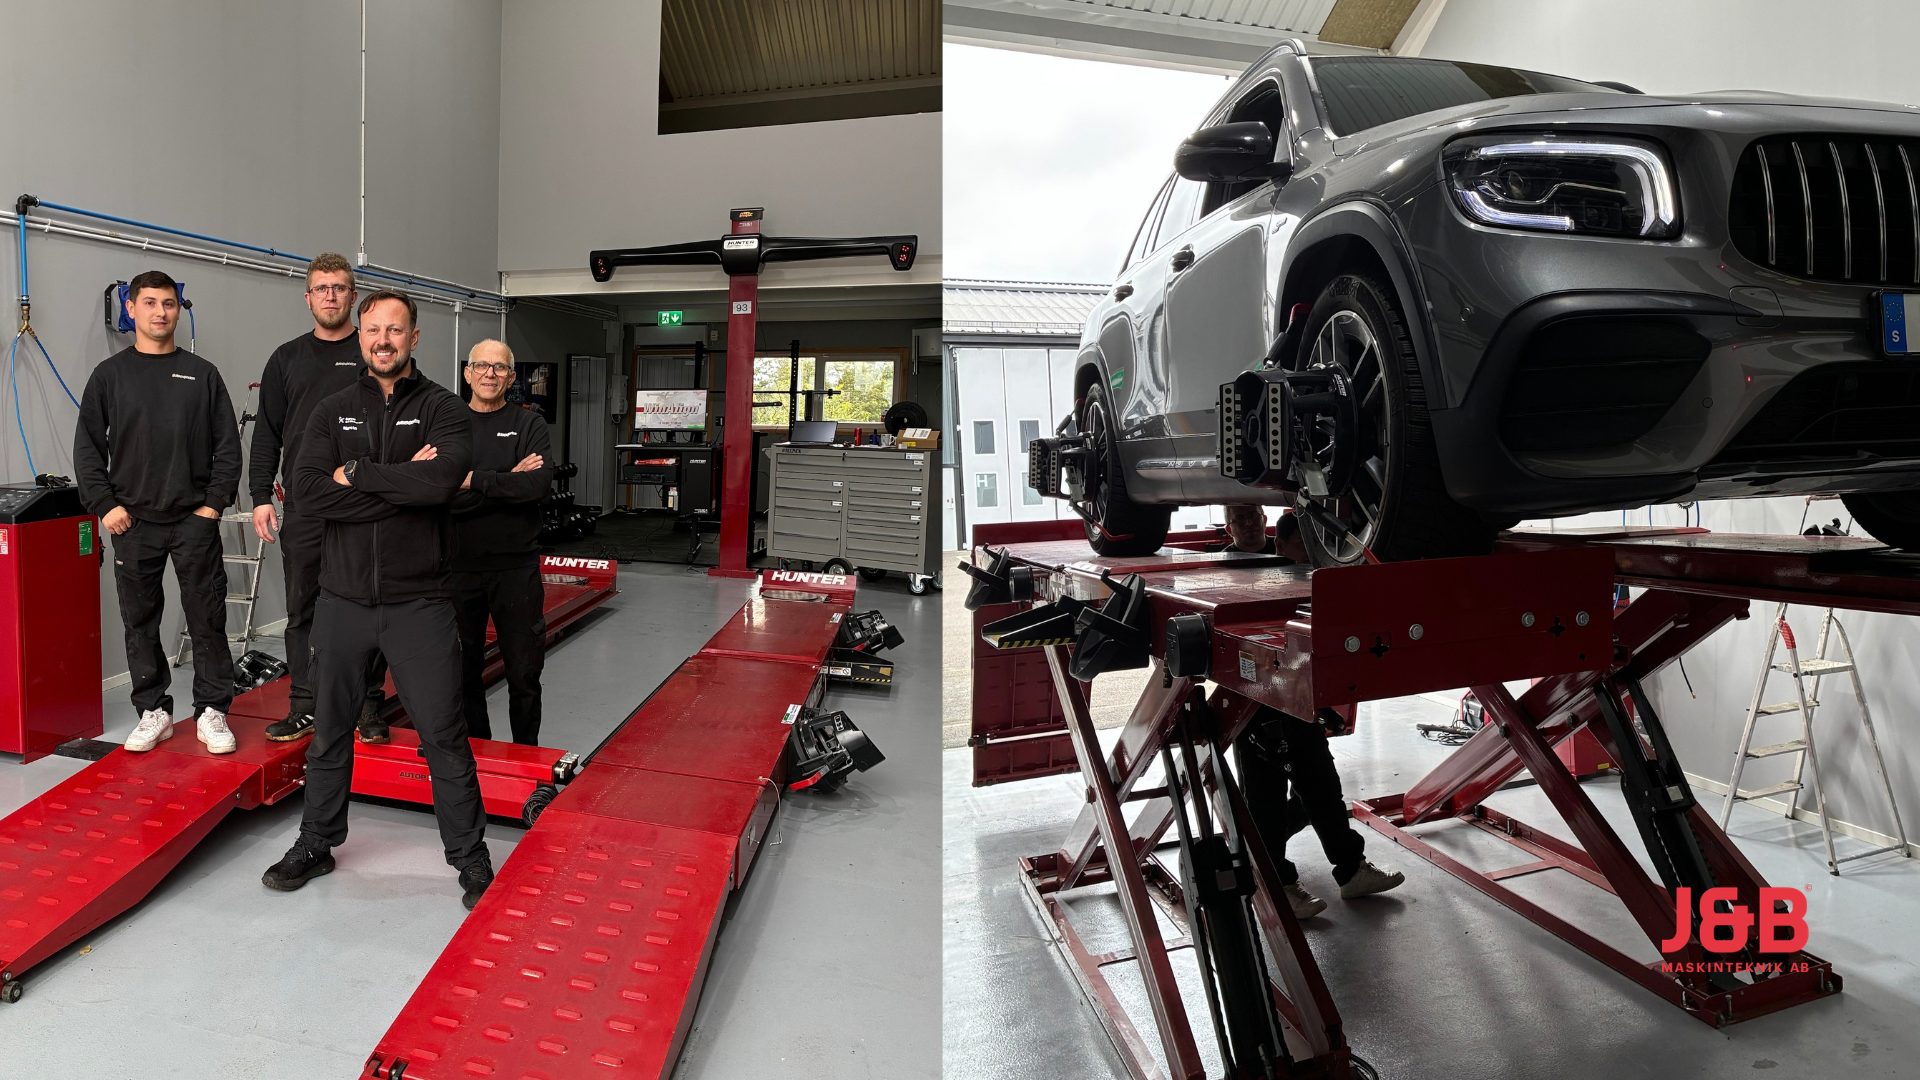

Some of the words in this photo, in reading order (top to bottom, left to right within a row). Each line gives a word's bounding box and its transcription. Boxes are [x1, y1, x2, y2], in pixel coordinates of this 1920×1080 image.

[735, 303, 748, 312] 93
[1892, 330, 1900, 343] S
[643, 402, 699, 417] WinAlign
[544, 556, 608, 570] HUNTER
[771, 571, 846, 585] HUNTER
[399, 771, 426, 780] AUTOP
